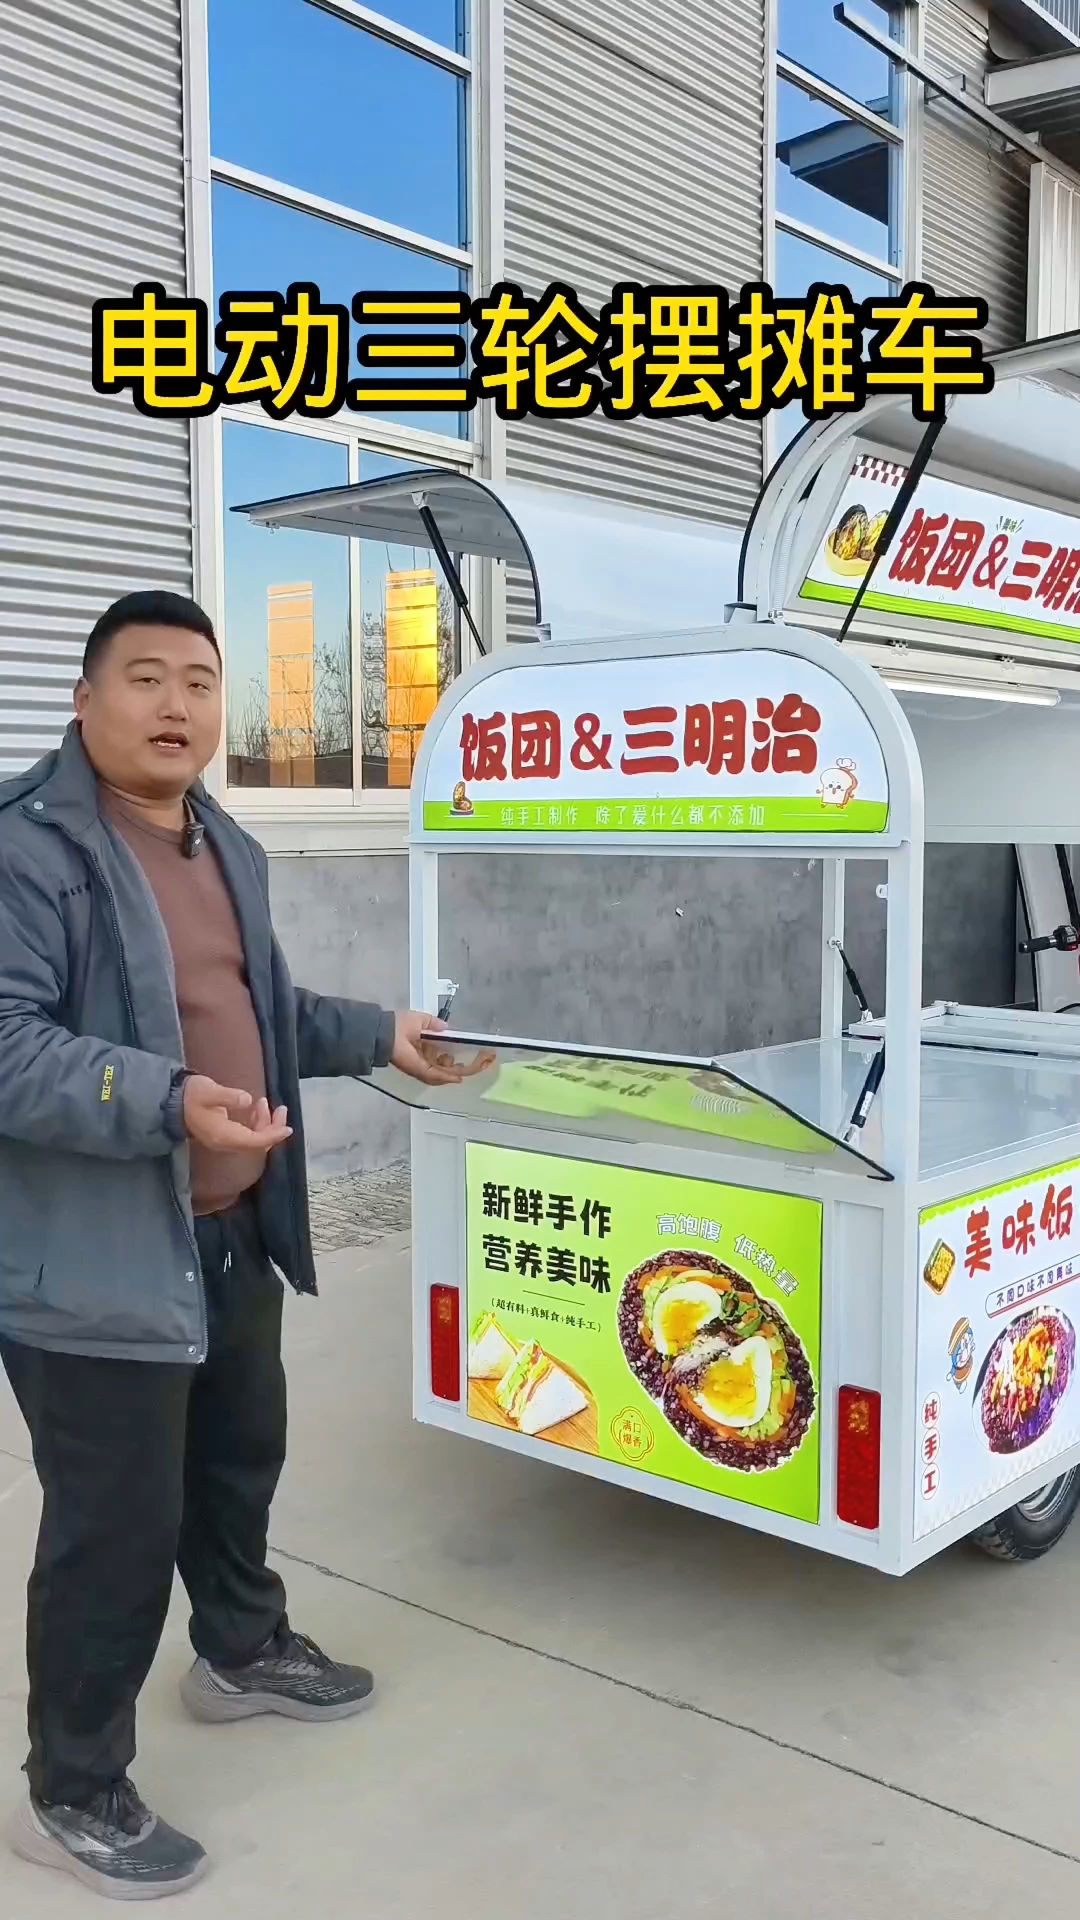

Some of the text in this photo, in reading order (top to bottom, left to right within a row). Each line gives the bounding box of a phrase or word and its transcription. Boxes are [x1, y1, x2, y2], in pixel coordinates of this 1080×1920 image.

[459, 693, 822, 782] 饭团&三明治
[500, 804, 765, 826] 纯手工制作 除了爱什么都不添加
[482, 1181, 612, 1239] 新鲜手作
[482, 1233, 612, 1294] 营养美味
[656, 1212, 801, 1298] 高饱腹 低热量
[924, 1399, 938, 1494] 纯手工
